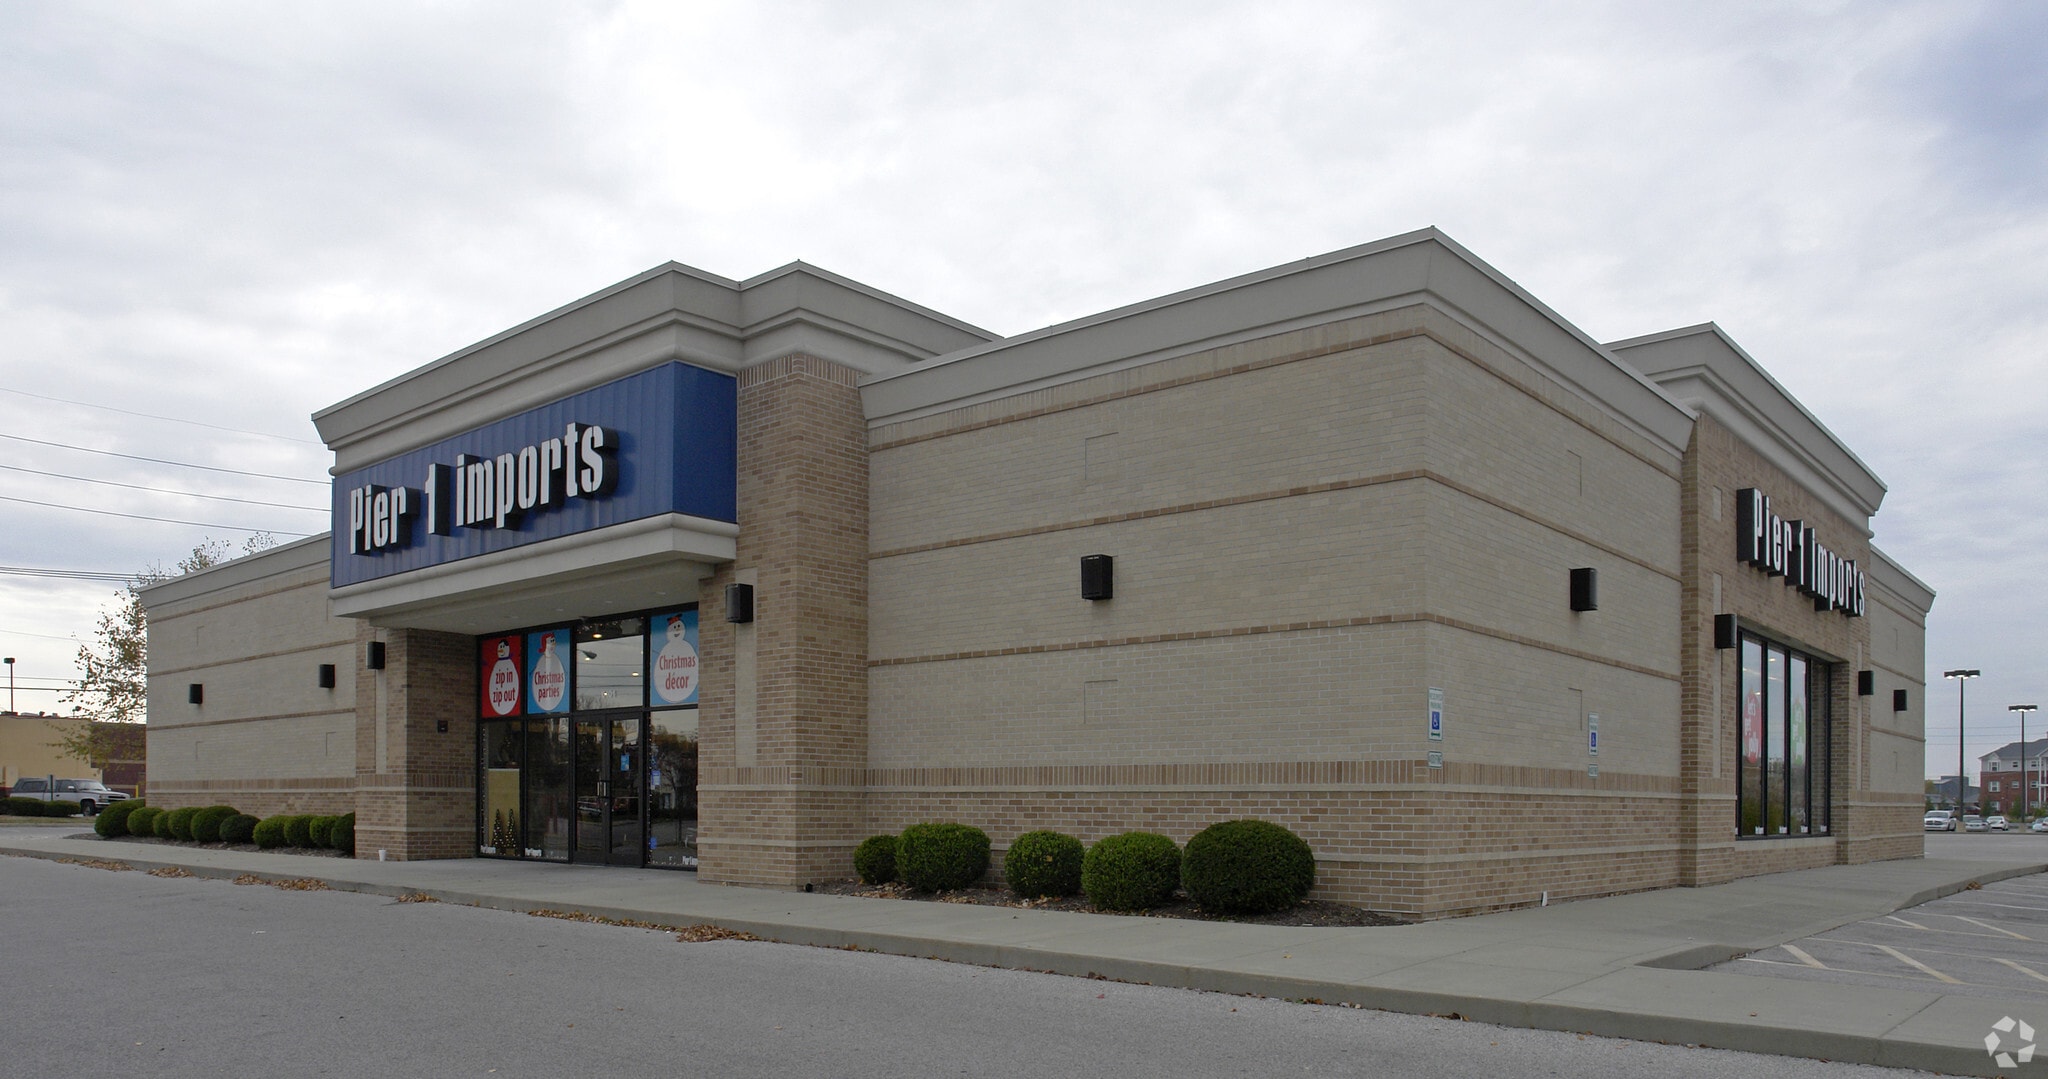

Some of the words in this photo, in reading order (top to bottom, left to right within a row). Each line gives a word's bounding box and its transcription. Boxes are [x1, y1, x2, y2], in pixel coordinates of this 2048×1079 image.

[350, 484, 408, 555] Pier
[424, 462, 439, 535] 1
[455, 421, 605, 529] imports
[1753, 487, 1793, 577] Pier
[1811, 527, 1866, 617] imports
[659, 655, 696, 670] Christmas
[496, 668, 506, 688] zip
[506, 667, 514, 684] in
[534, 671, 564, 685] Christmas
[665, 672, 690, 690] décor
[493, 687, 503, 707] zip
[504, 687, 516, 701] out
[538, 684, 560, 702] parties
